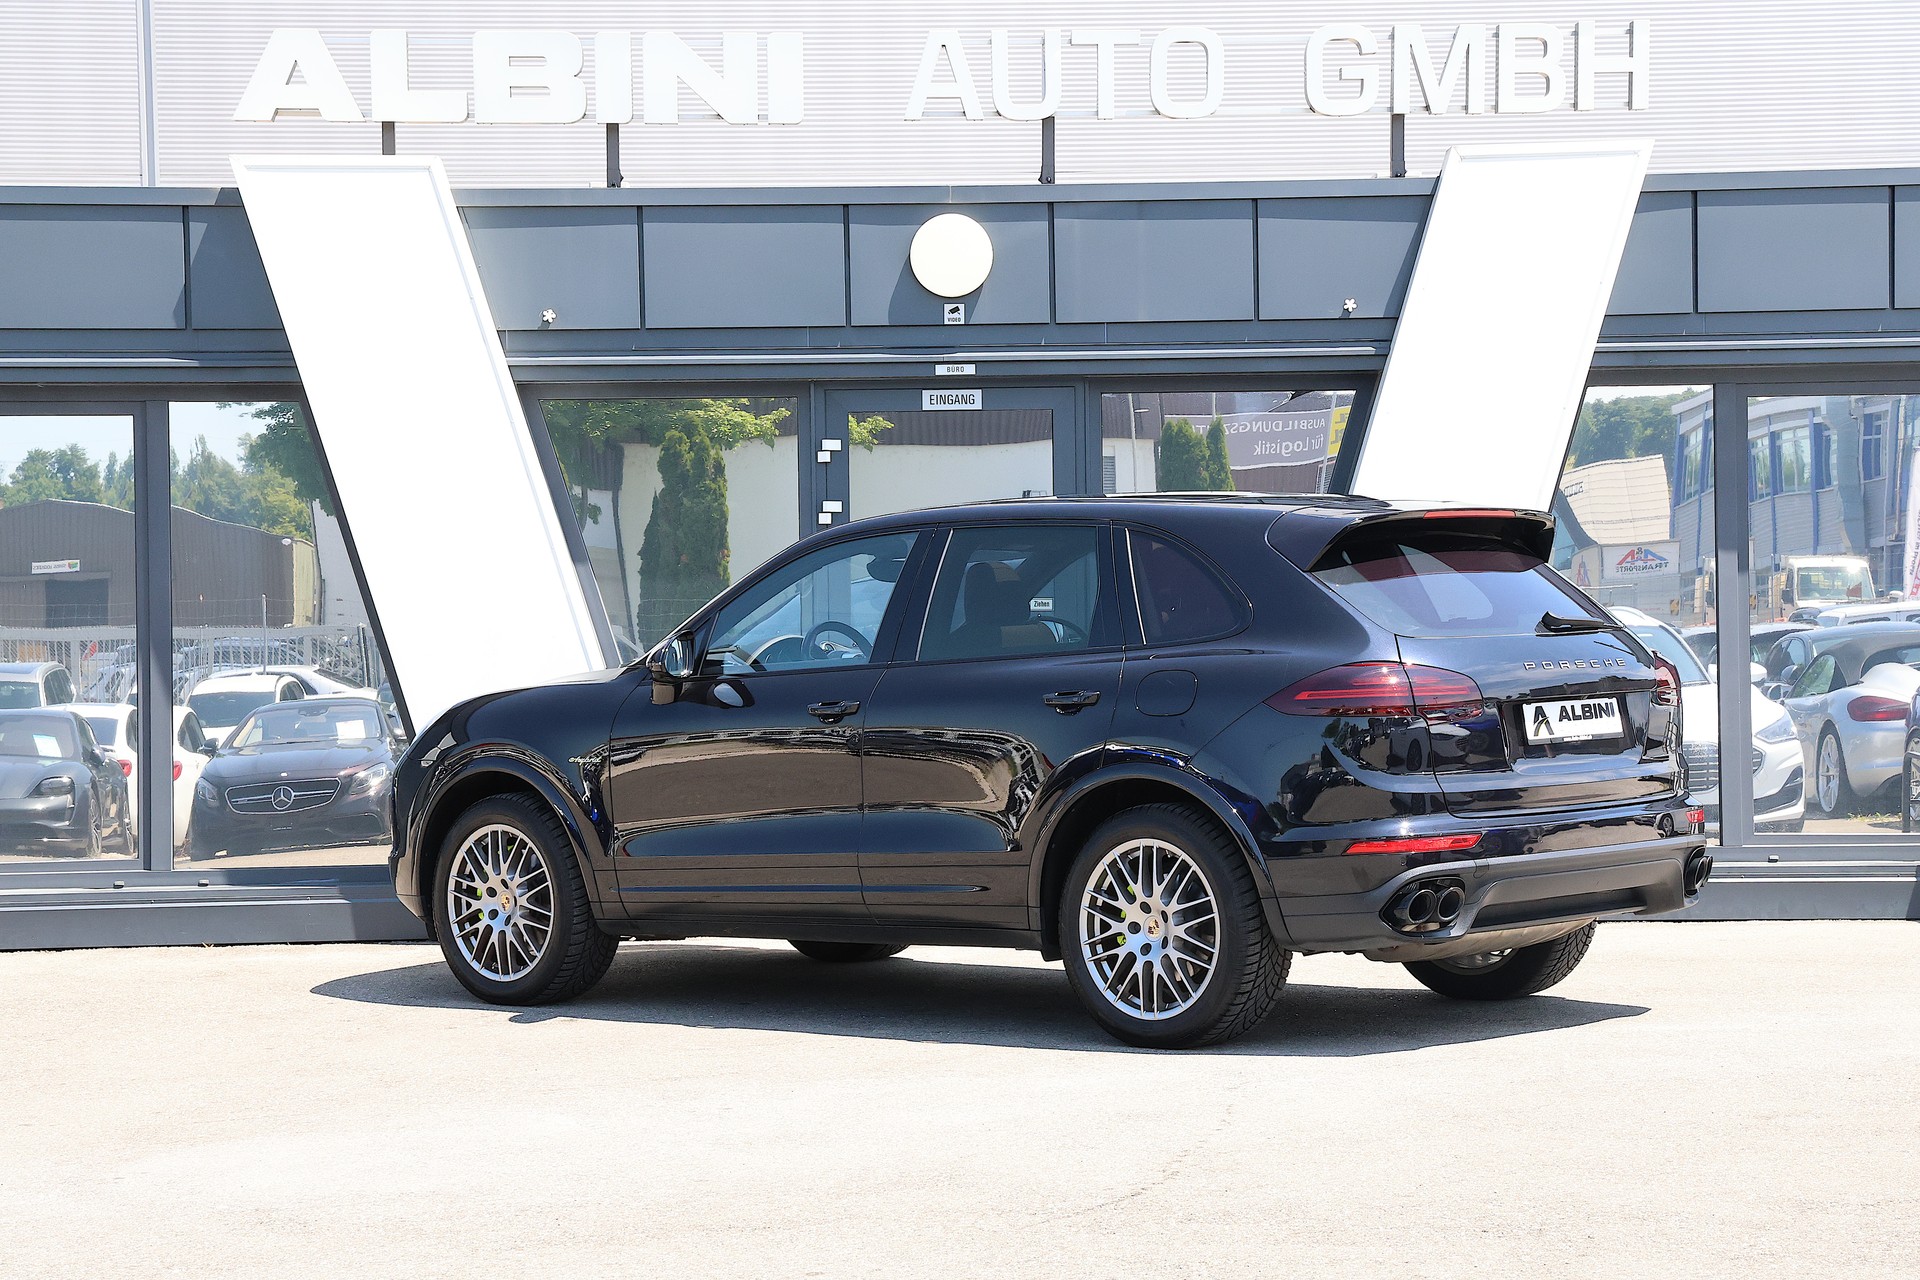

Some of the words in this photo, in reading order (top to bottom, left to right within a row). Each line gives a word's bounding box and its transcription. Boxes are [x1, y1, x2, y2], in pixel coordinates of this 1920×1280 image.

[233, 28, 804, 125] ALBINI
[902, 26, 1225, 121] AUTO
[1304, 19, 1651, 116] GMBH
[946, 364, 965, 373] BÜRO
[929, 393, 976, 406] EINGANG
[1523, 658, 1627, 670] PORSCHE
[1559, 702, 1616, 723] ALBINI
